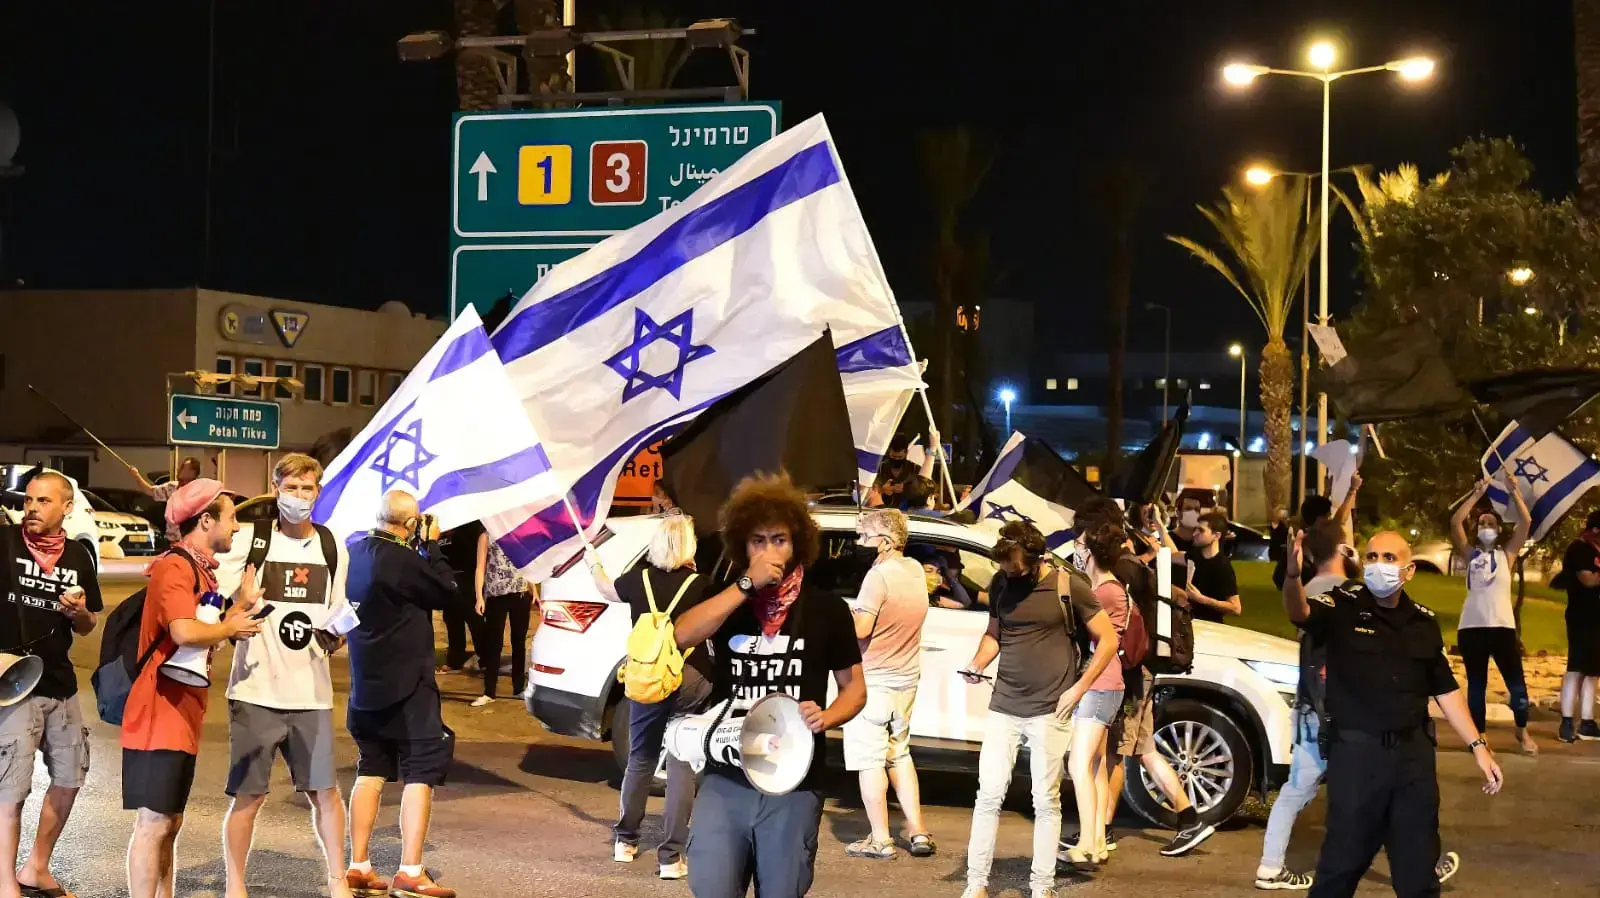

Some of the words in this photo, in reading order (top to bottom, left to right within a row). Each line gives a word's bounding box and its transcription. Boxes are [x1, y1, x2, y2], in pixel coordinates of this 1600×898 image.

[668, 125, 749, 147] טרמינל
[536, 155, 552, 194] 1
[605, 152, 631, 193] 3
[215, 406, 239, 422] תקוה
[243, 408, 262, 422] פתח
[209, 423, 238, 438] Petah
[241, 426, 267, 440] Tikva
[622, 460, 660, 478] Ret
[283, 586, 307, 598] מצב
[731, 658, 803, 681] חקירה
